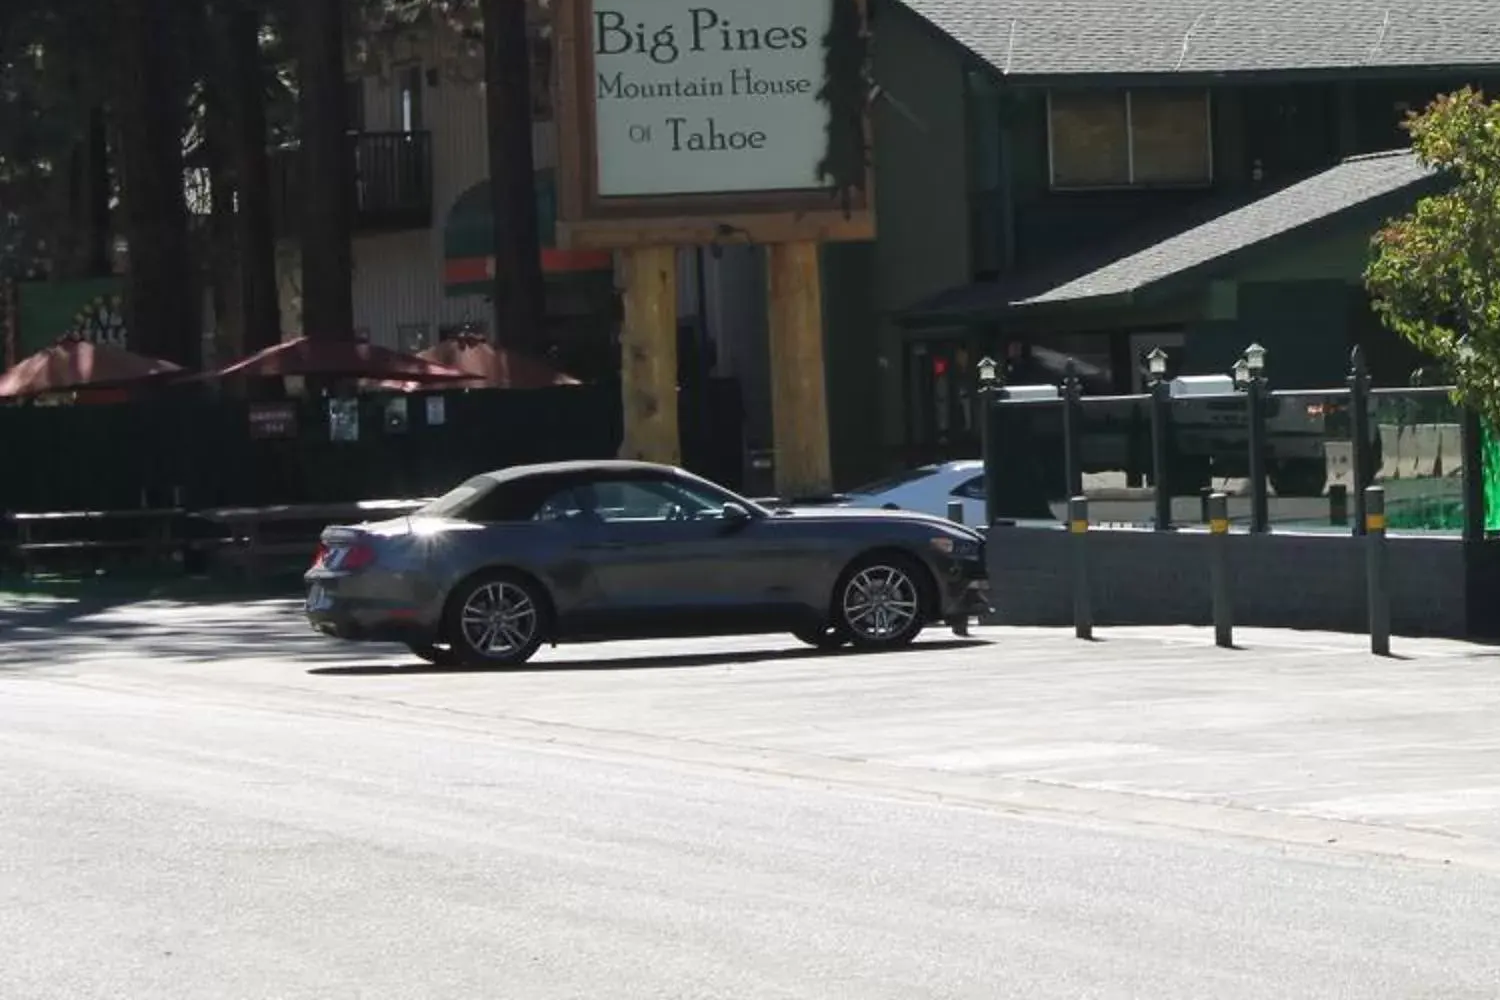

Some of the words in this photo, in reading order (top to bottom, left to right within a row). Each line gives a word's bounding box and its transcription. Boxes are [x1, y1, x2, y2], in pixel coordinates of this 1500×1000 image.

[593, 10, 679, 64] Big
[688, 7, 807, 51] Pines
[597, 70, 723, 99] Mountain
[730, 67, 812, 96] House
[665, 117, 767, 151] Tahoe
